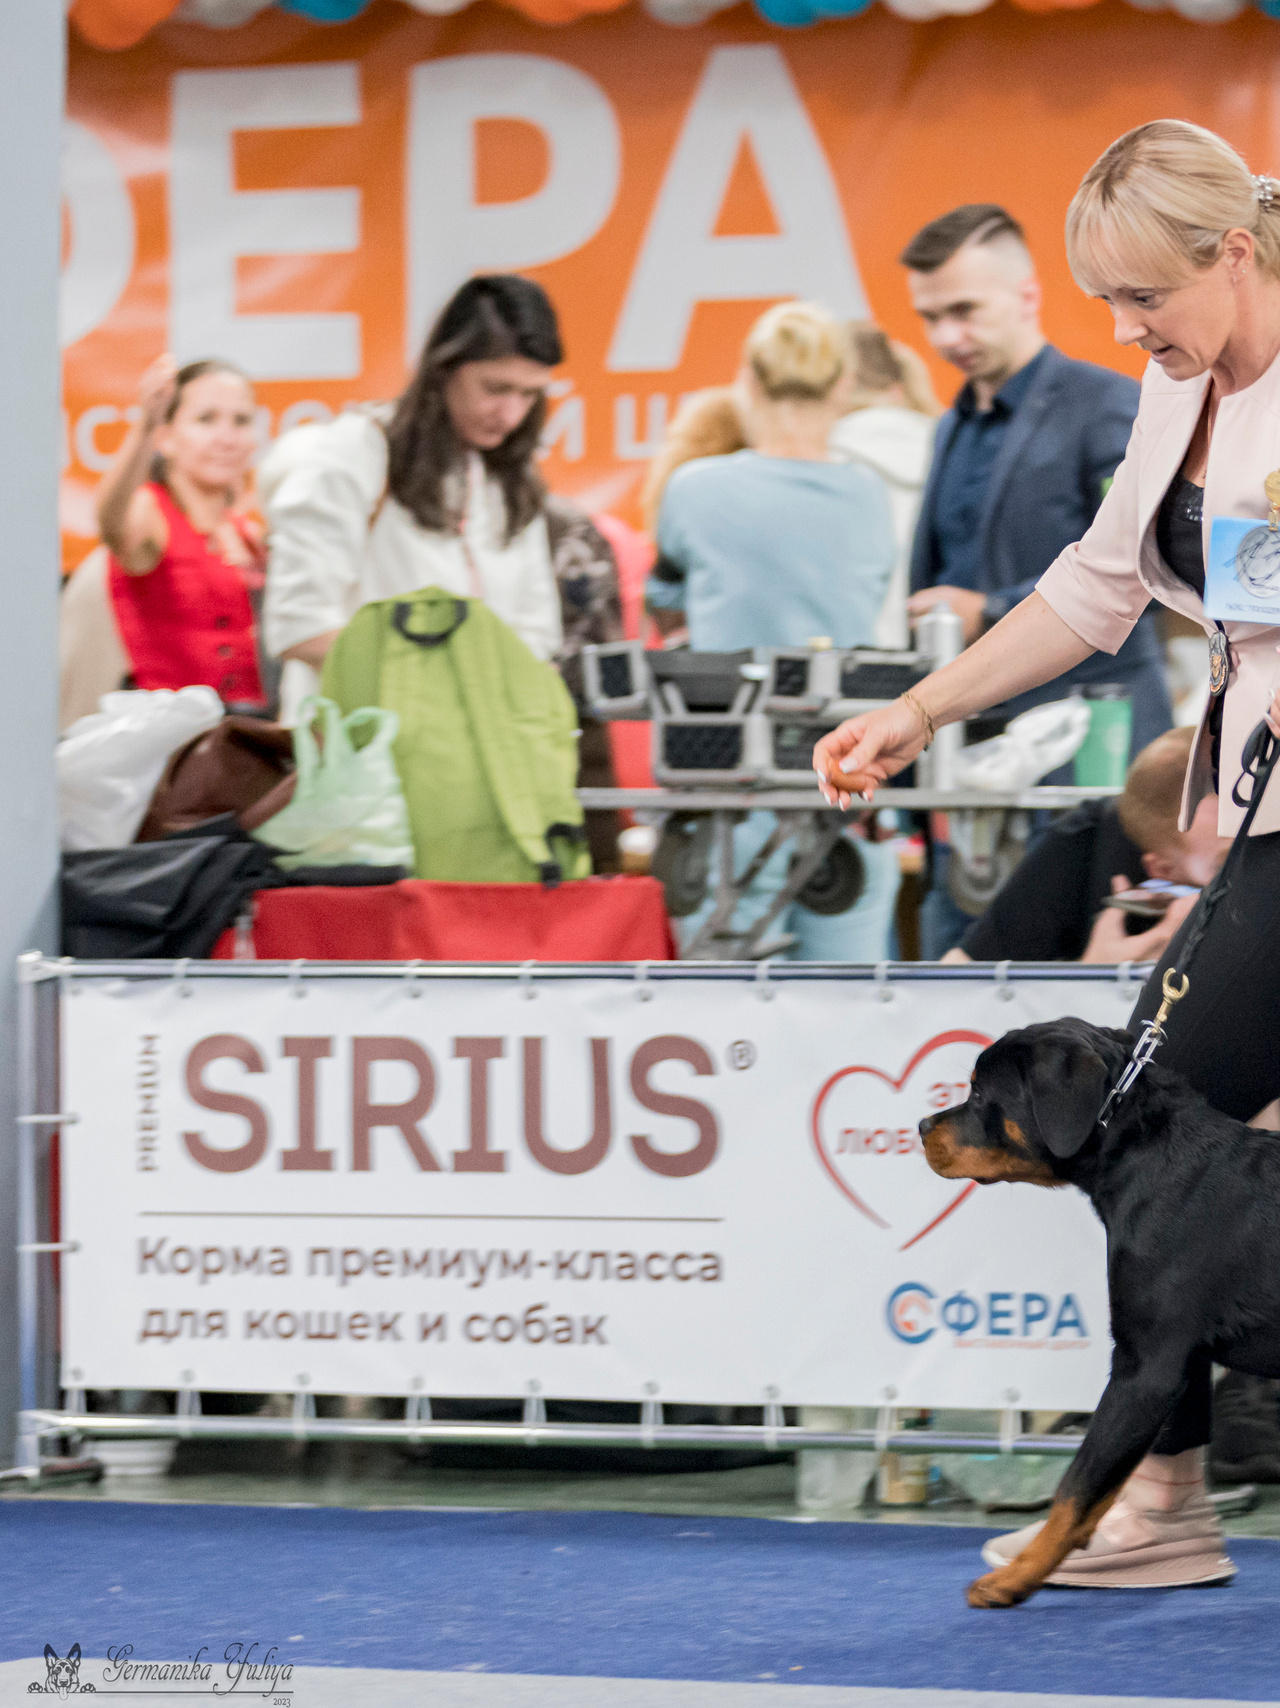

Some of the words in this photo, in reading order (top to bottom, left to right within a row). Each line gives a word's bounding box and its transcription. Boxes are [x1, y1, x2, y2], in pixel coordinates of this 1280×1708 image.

[135, 1033, 161, 1173] PREMIUM
[180, 1032, 721, 1178] SIRIUS
[928, 1081, 970, 1108] ЭТ
[836, 1126, 925, 1155] ЛЮБ
[137, 1236, 292, 1286] Корма
[306, 1245, 724, 1289] премиум-класса
[138, 1307, 228, 1344] для
[243, 1309, 404, 1343] кошек
[419, 1312, 447, 1343] и
[463, 1302, 610, 1345] собак
[885, 1281, 1089, 1345] СФЕРА
